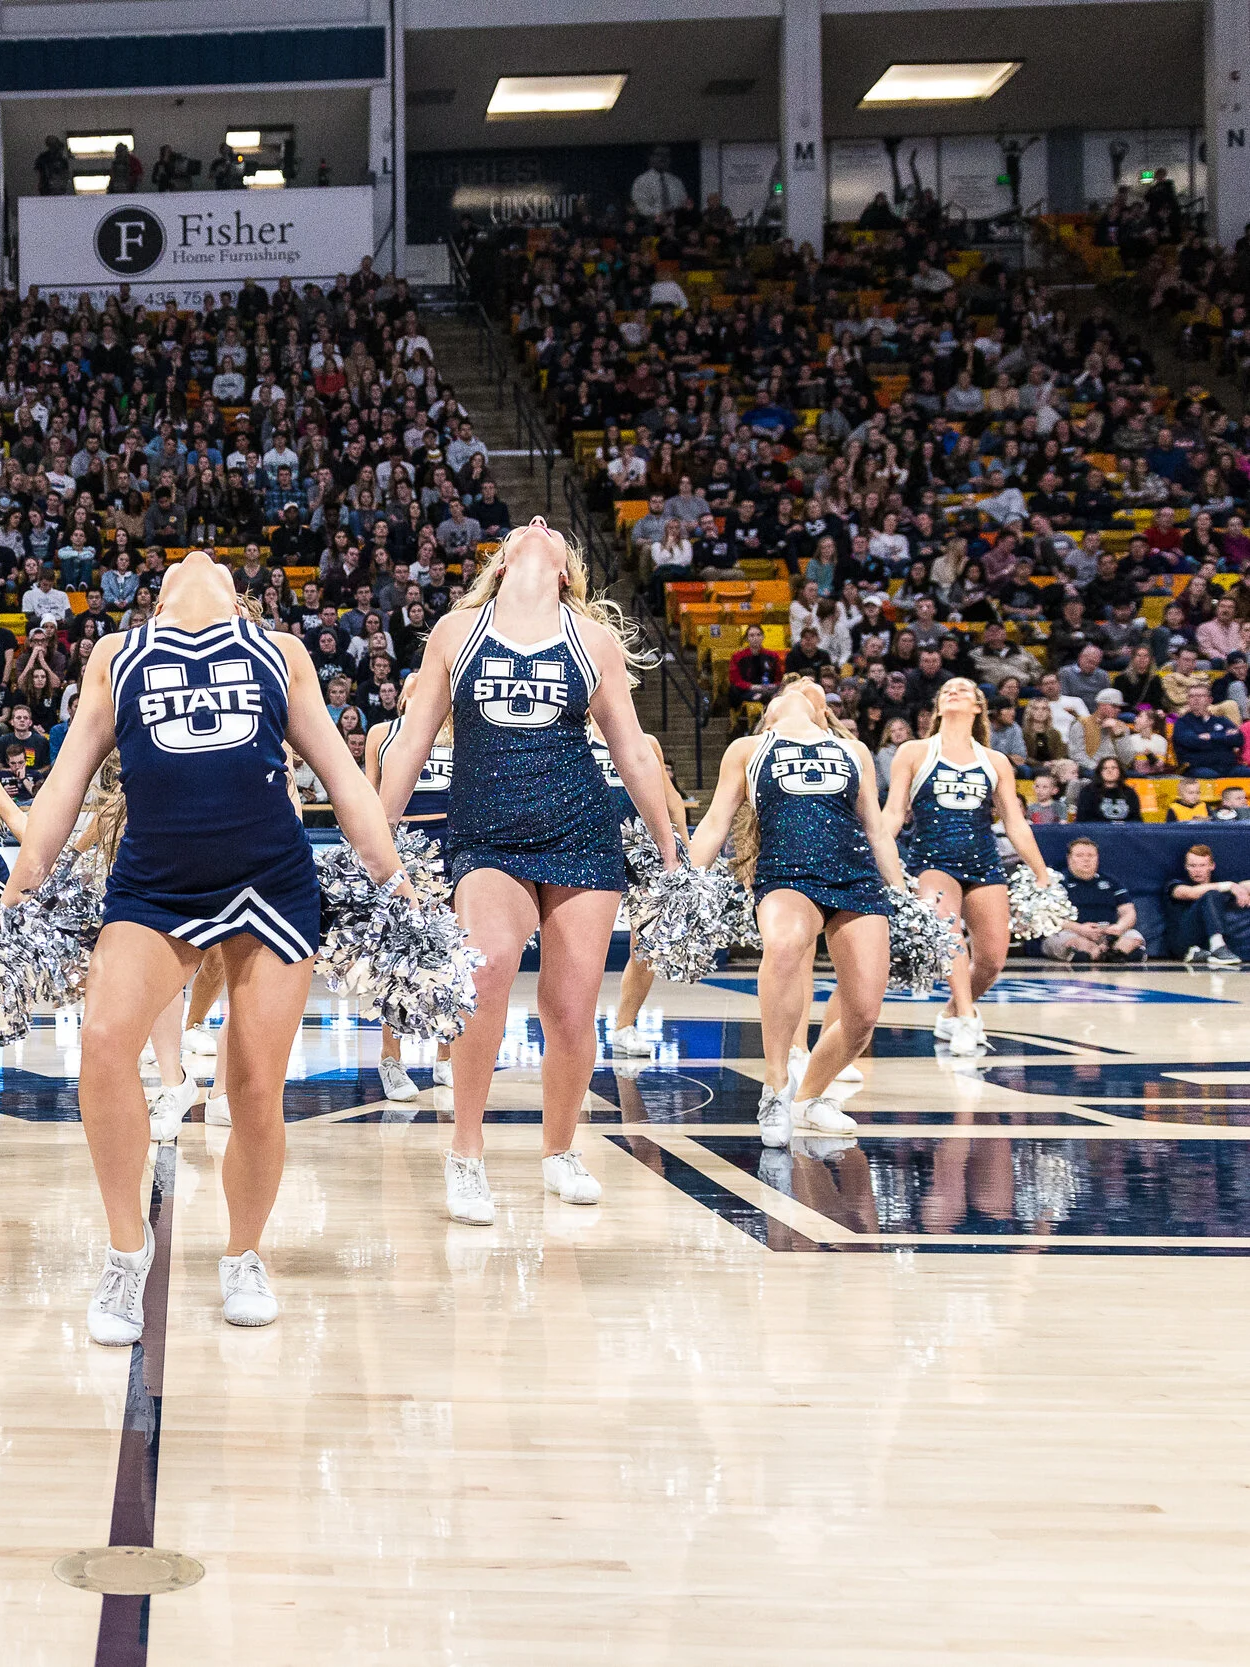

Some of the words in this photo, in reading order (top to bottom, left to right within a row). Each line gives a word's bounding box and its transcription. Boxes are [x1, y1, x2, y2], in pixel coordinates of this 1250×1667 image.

[794, 141, 815, 160] M
[177, 209, 294, 247] Fisher
[115, 221, 146, 261] F
[172, 250, 216, 264] Home
[219, 247, 301, 264] Furnishings
[473, 678, 569, 708] STATE
[138, 683, 263, 726] STATE
[423, 760, 454, 778] ATE
[770, 758, 852, 780] STATE
[932, 780, 989, 799] STATE
